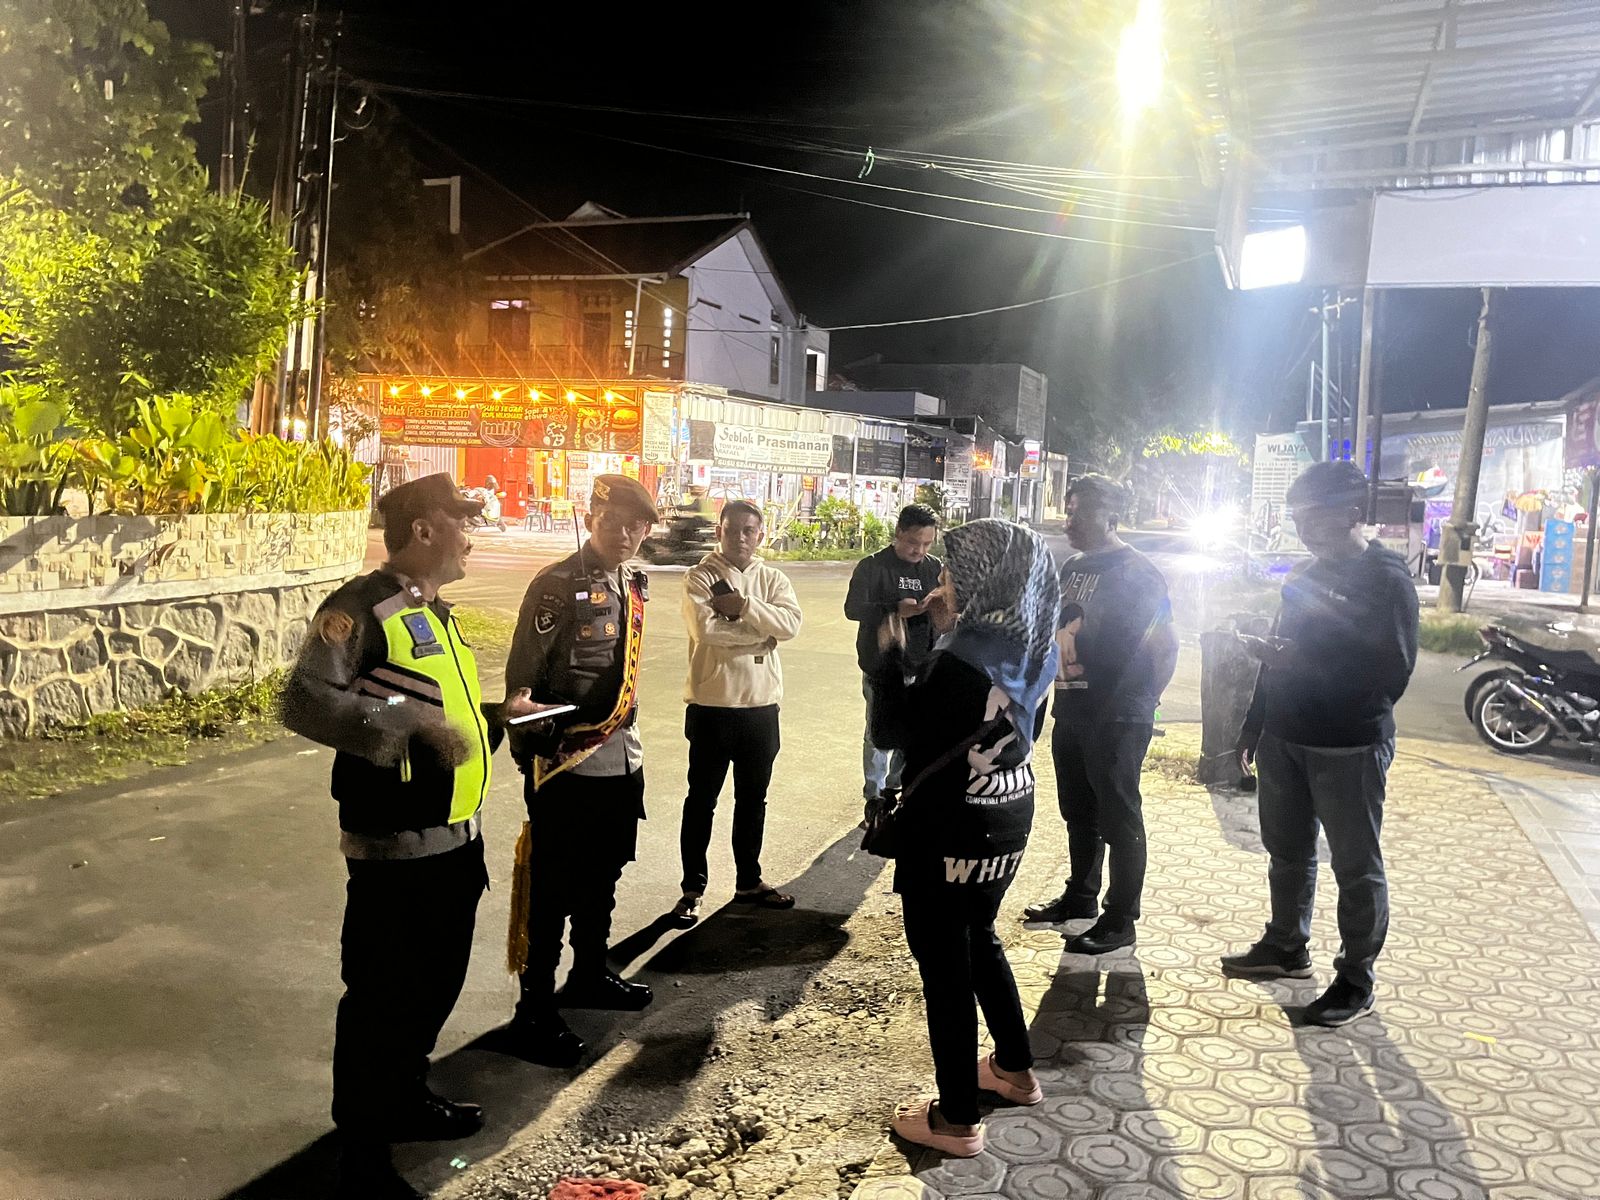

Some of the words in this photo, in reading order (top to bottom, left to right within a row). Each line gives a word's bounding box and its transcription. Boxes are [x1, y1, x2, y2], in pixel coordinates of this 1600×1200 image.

[406, 406, 470, 418] Prasmanan
[719, 427, 754, 444] Seblak
[756, 434, 829, 452] Prasmanan
[1267, 444, 1307, 453] WIJAYA
